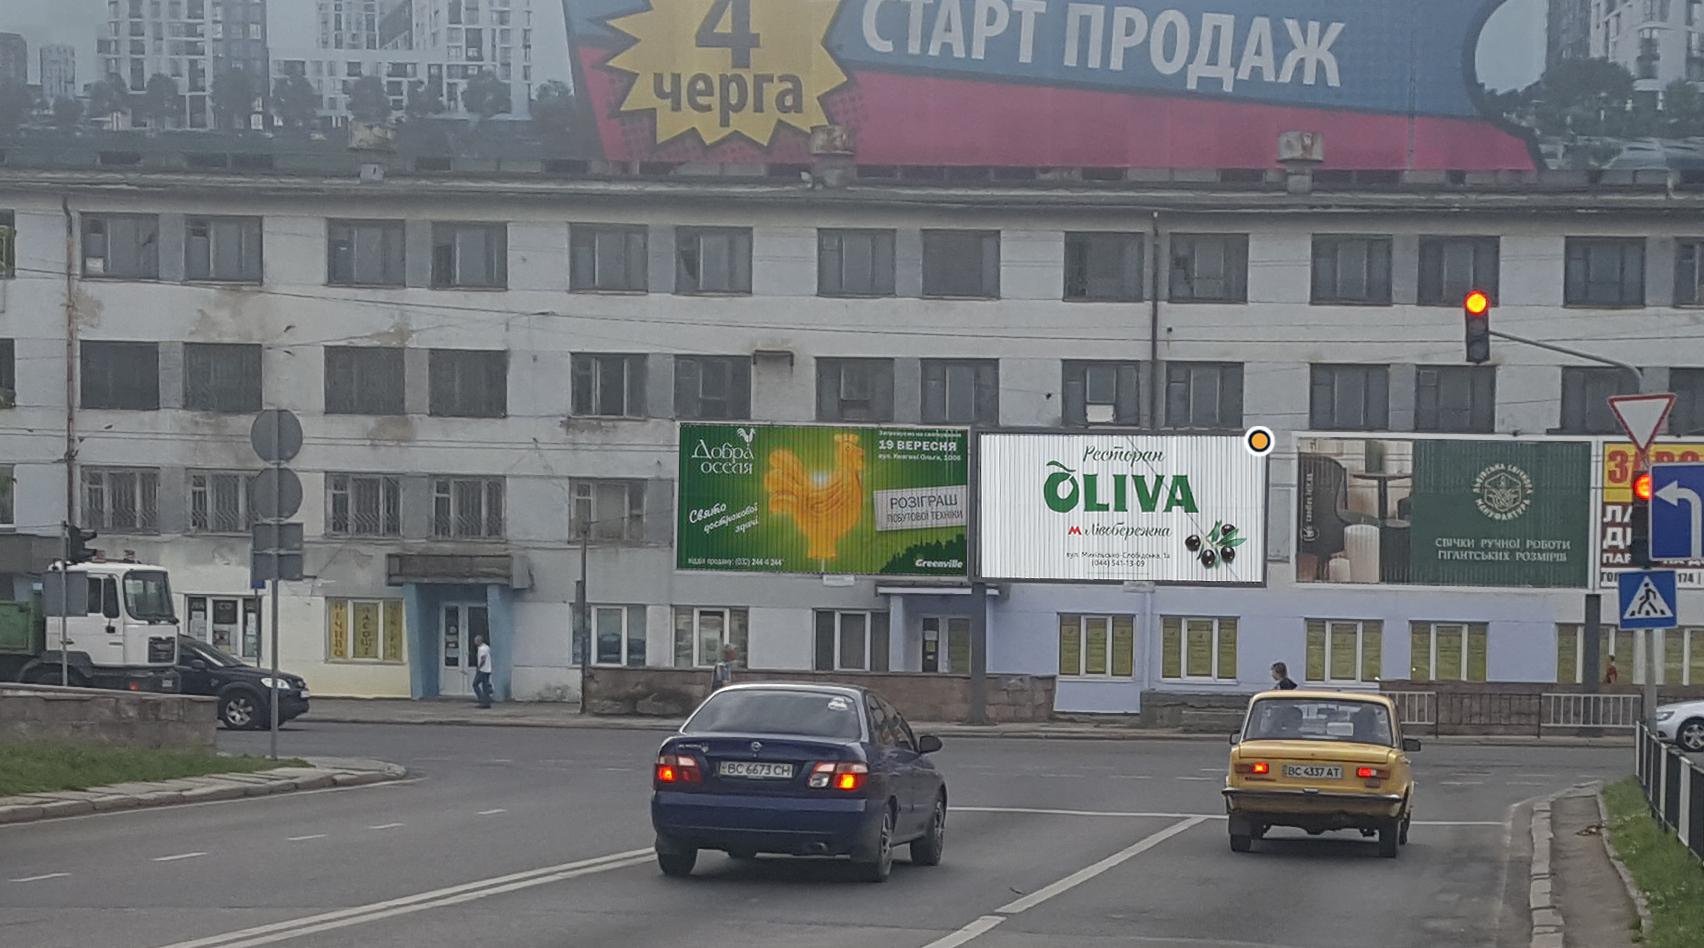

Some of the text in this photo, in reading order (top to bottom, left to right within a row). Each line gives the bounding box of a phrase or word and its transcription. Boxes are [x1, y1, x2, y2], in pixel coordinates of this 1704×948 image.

[695, 0, 760, 69] 4
[862, 0, 1346, 92] СТАРТ ПРОДАЖ
[653, 72, 804, 128] черга
[879, 440, 957, 451] 19 ВЕРЕСНЯ
[1083, 445, 1165, 467] Ресторан
[890, 494, 958, 509] РОЗІГРАШ
[689, 503, 727, 524] Свято
[1085, 522, 1172, 540] Лівобережна
[1435, 538, 1475, 548] СВІЧКИ
[1526, 539, 1571, 550] РОБОТИ
[1437, 550, 1567, 562] ГІГАНТСЬКИХ РОЗМІРІВ
[915, 559, 963, 568] Greenville
[1678, 572, 1694, 582] 174
[745, 763, 771, 775] 6673
[1303, 767, 1325, 777] 4337
